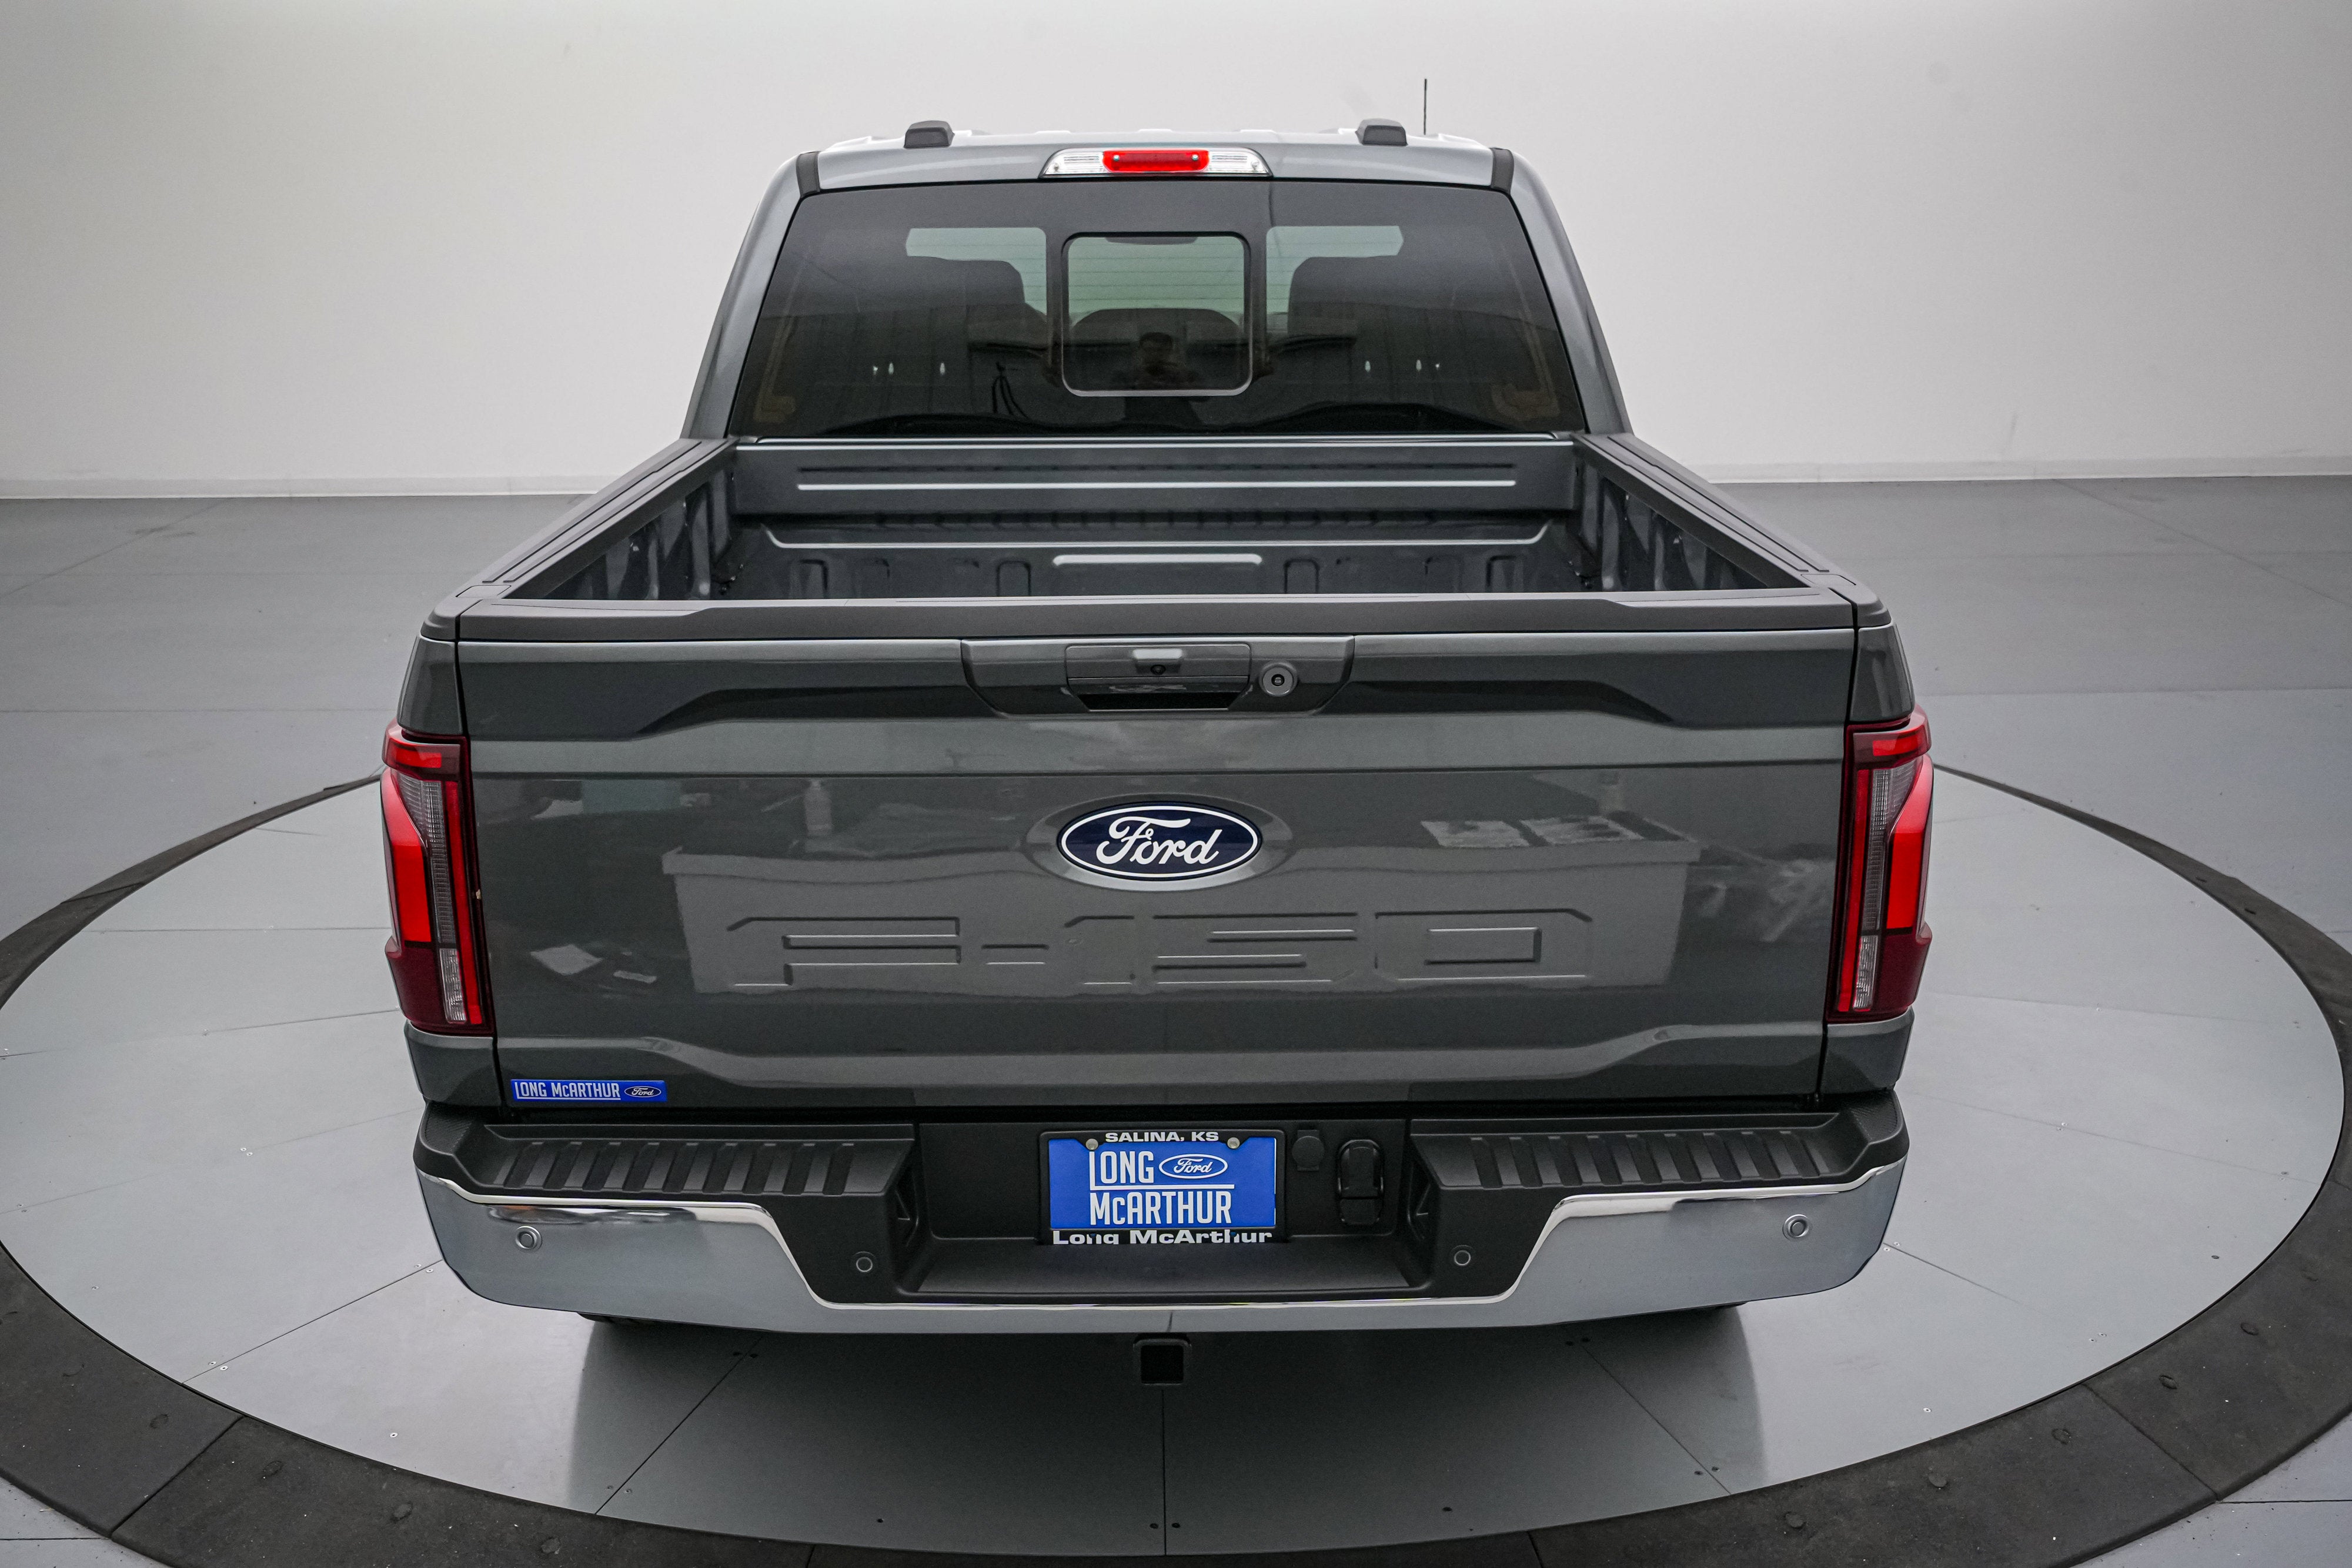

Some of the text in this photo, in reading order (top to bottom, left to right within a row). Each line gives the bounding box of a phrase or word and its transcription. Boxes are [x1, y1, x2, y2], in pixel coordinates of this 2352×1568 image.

[1096, 816, 1222, 865] Ford
[514, 1082, 621, 1098] LONG McARTHUR
[631, 1087, 654, 1096] Ford
[1105, 1131, 1219, 1142] SALINA, KS
[1089, 1151, 1154, 1186] LONG
[1173, 1158, 1214, 1174] Ford
[1090, 1191, 1232, 1225] McARTHUR
[1130, 1229, 1272, 1245] McArthur
